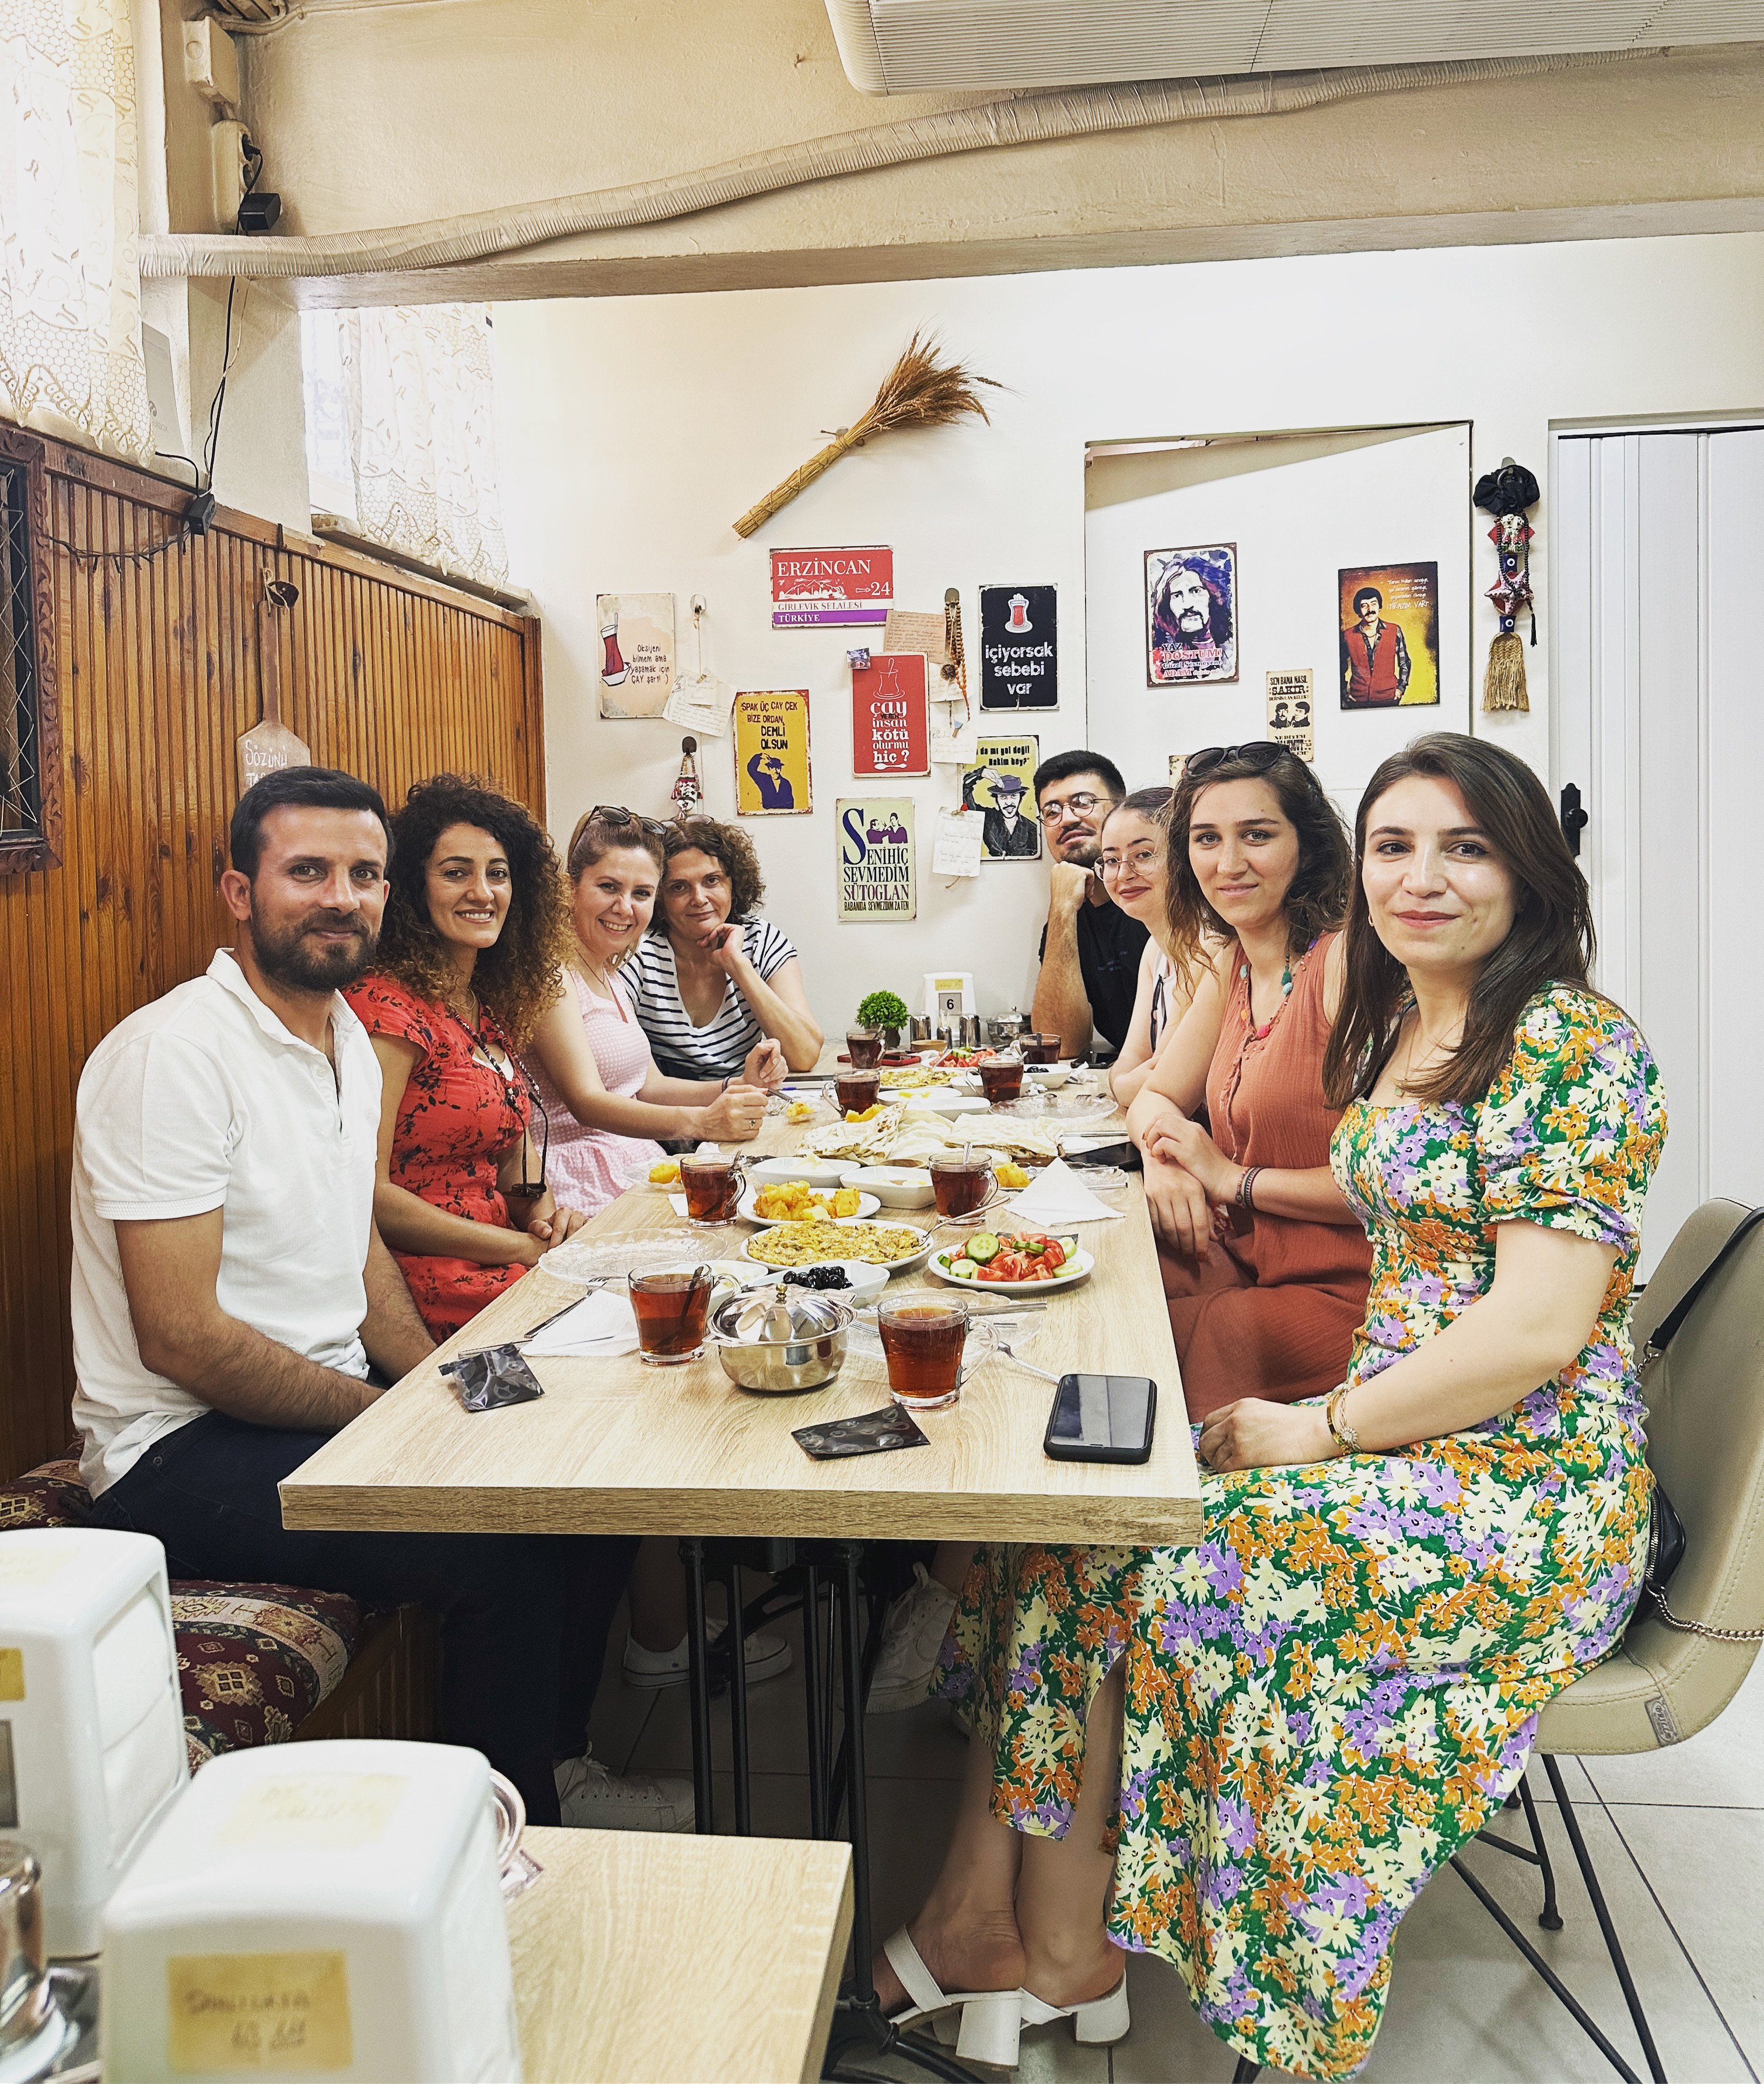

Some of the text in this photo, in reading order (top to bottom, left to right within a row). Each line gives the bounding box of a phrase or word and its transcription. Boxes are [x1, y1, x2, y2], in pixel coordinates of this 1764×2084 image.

[777, 557, 871, 576] ERZİNCAN
[870, 582, 891, 596] 24
[778, 602, 818, 611] GİRLEVİK
[779, 613, 820, 623] TÜRKİYE
[638, 644, 660, 653] Oksijeni
[985, 642, 1054, 663] içiyorsak
[1163, 648, 1222, 660] DOSTUM!
[632, 653, 652, 663] bilmem
[630, 665, 670, 675] yaşamak için
[994, 660, 1044, 677] sebebi
[631, 674, 643, 684] ÇAY
[1270, 677, 1280, 685] SEN
[1280, 676, 1293, 684] BANA
[1007, 683, 1032, 695] var
[760, 701, 769, 712] ÜÇ
[785, 701, 797, 711] ÇEK
[870, 701, 907, 718] çay
[747, 712, 761, 723] BİZE
[873, 718, 908, 728] insan
[761, 724, 785, 737] DEMLİ
[872, 729, 909, 741] kötü
[761, 738, 788, 750] OLSUN
[873, 750, 909, 764] hiç ?
[844, 864, 909, 882] SEVMEDİM
[895, 901, 909, 910] ZATEN
[946, 998, 954, 1010] 6
